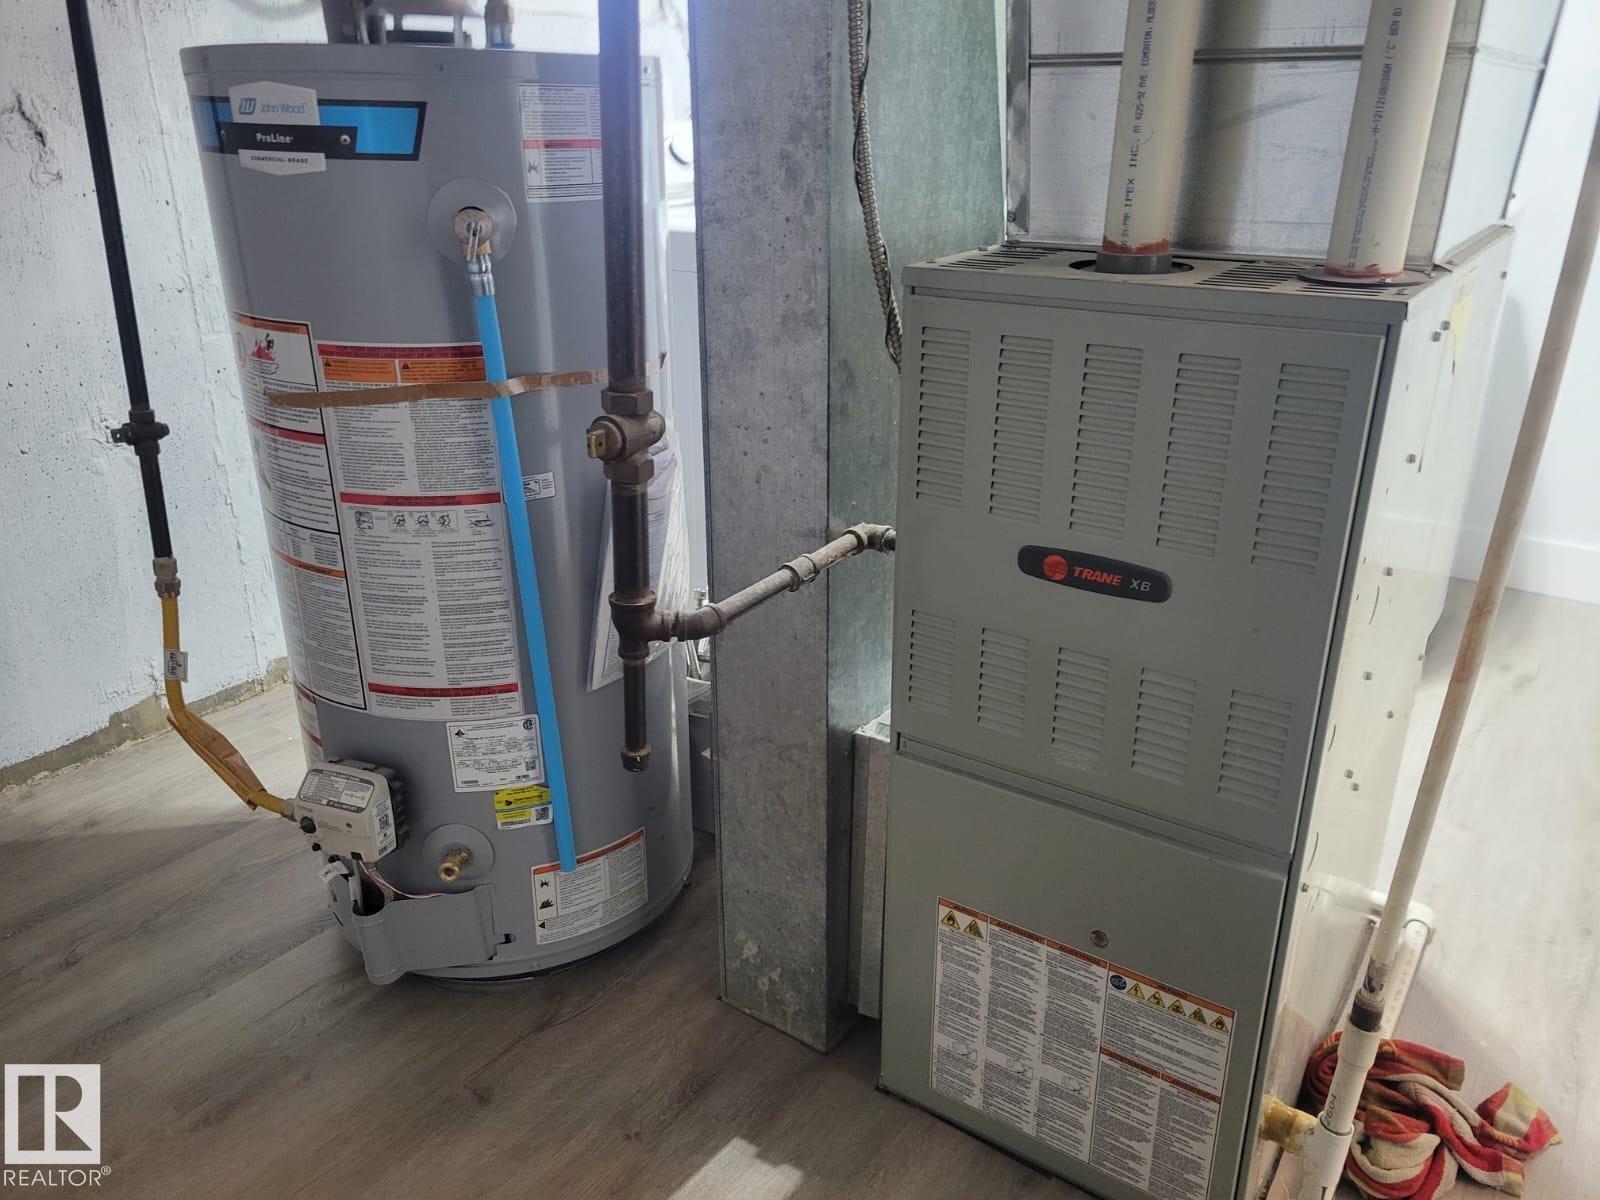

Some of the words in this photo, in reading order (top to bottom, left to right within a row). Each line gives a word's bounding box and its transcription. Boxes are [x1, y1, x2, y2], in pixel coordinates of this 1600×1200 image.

[1129, 138, 1140, 168] INC.
[1124, 177, 1136, 208] IPEX
[1073, 566, 1123, 586] TRANE
